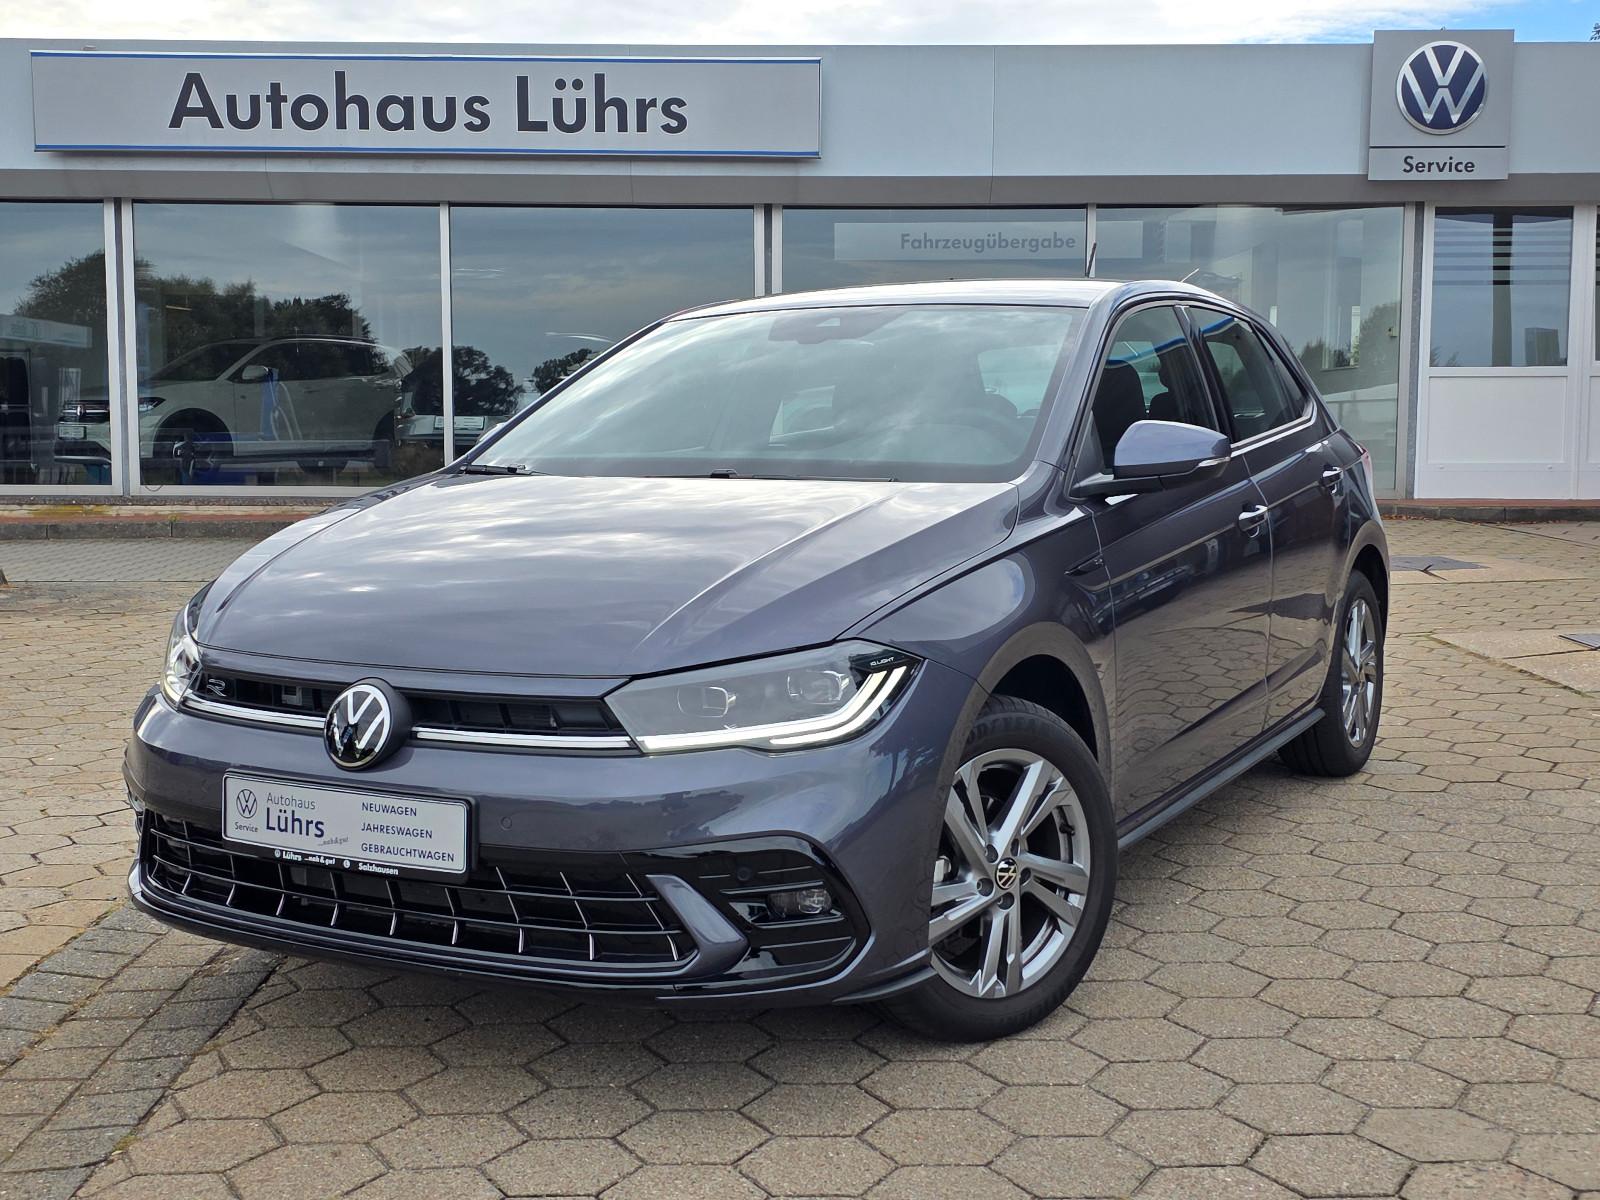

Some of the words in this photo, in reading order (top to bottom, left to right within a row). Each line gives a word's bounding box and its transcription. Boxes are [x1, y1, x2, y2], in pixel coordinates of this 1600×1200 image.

[1396, 40, 1488, 135] VW
[168, 70, 491, 131] Autohaus
[515, 72, 688, 134] Lührs
[1403, 155, 1475, 173] Service
[900, 232, 1077, 254] Fahrzeugübergabe
[266, 792, 316, 810] Autohaus
[361, 802, 417, 817] NEUWAGEN
[234, 821, 259, 833] Service
[266, 807, 325, 838] Lührs
[360, 822, 433, 839] JAHRESWAGEN
[361, 842, 455, 862] GEBRAUCHTWAGEN
[282, 850, 302, 862] Lührs
[358, 863, 399, 875] Salzhausen
